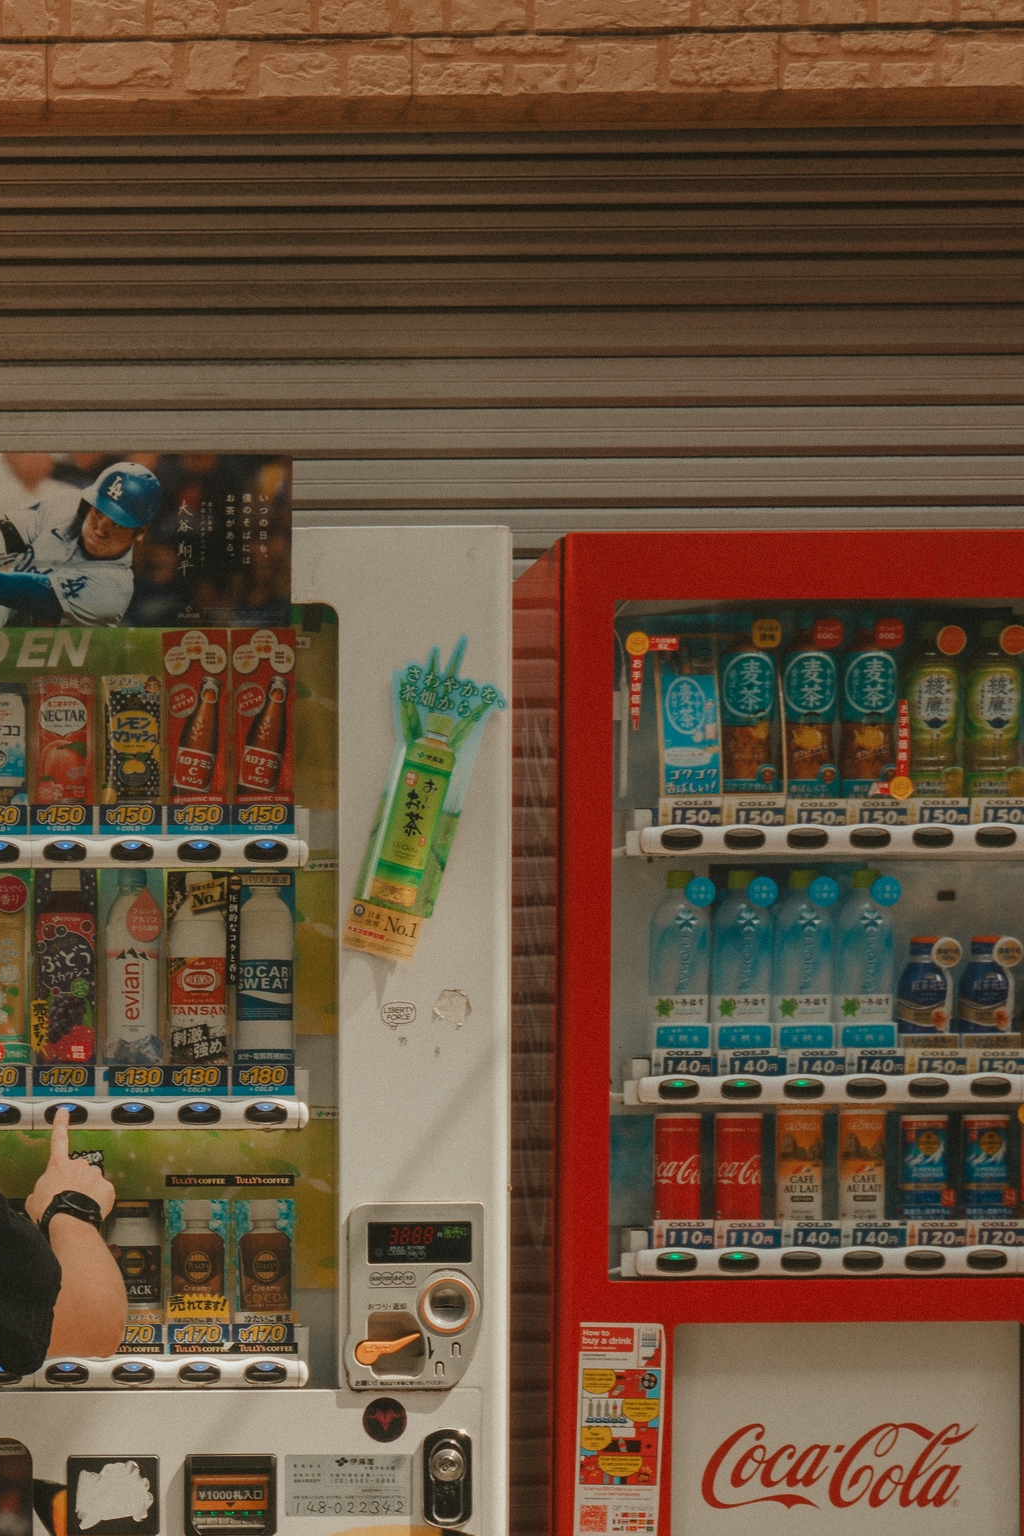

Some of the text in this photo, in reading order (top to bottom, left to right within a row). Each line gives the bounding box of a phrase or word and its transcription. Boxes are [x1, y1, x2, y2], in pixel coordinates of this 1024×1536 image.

[15, 629, 93, 668] EN
[739, 659, 764, 711] 麦茶
[801, 658, 823, 708] 麦茶
[862, 658, 885, 708] 麦茶
[923, 674, 947, 717] 綾鷹
[986, 674, 1010, 717] 綾鷹
[40, 709, 86, 723] NECTAR
[116, 717, 151, 729] レモン
[108, 729, 159, 743] スカッシュ
[189, 767, 198, 776] C
[255, 766, 265, 775] C
[669, 769, 718, 780] ゴクゴク
[181, 776, 203, 785] ドリンク
[248, 775, 269, 784] ドリンク
[37, 806, 84, 824] ¥150
[108, 806, 154, 824] ¥150
[175, 805, 222, 823] ¥150
[240, 805, 286, 823] ¥150
[676, 809, 720, 824] 150円
[191, 881, 227, 907] No.1
[383, 915, 418, 938] No.1
[42, 945, 92, 973] ぶどう
[50, 968, 90, 985] スカッシュ
[238, 977, 289, 989] SWEAT
[122, 961, 141, 1021] evian
[171, 1006, 226, 1016] TANSAN
[383, 1006, 414, 1014] LIBERTY
[386, 1013, 410, 1021] FORCE
[40, 1067, 87, 1085] ¥170
[116, 1068, 162, 1085] ¥130
[174, 1068, 219, 1085] ¥130
[198, 1177, 225, 1185] COFFEE
[789, 1174, 814, 1183] CAFÉ
[852, 1174, 877, 1183] CAFÉ
[784, 1185, 797, 1193] AU
[846, 1185, 860, 1193] AU
[183, 1285, 212, 1293] Creamy
[252, 1284, 280, 1293] Creamy
[582, 1329, 610, 1337] How to
[582, 1337, 599, 1346] buy
[609, 1336, 632, 1345] drink
[701, 1422, 979, 1510] Coca-Cola
[198, 1490, 263, 1500] ¥1000札入口
[295, 1501, 404, 1514] 148-022342
